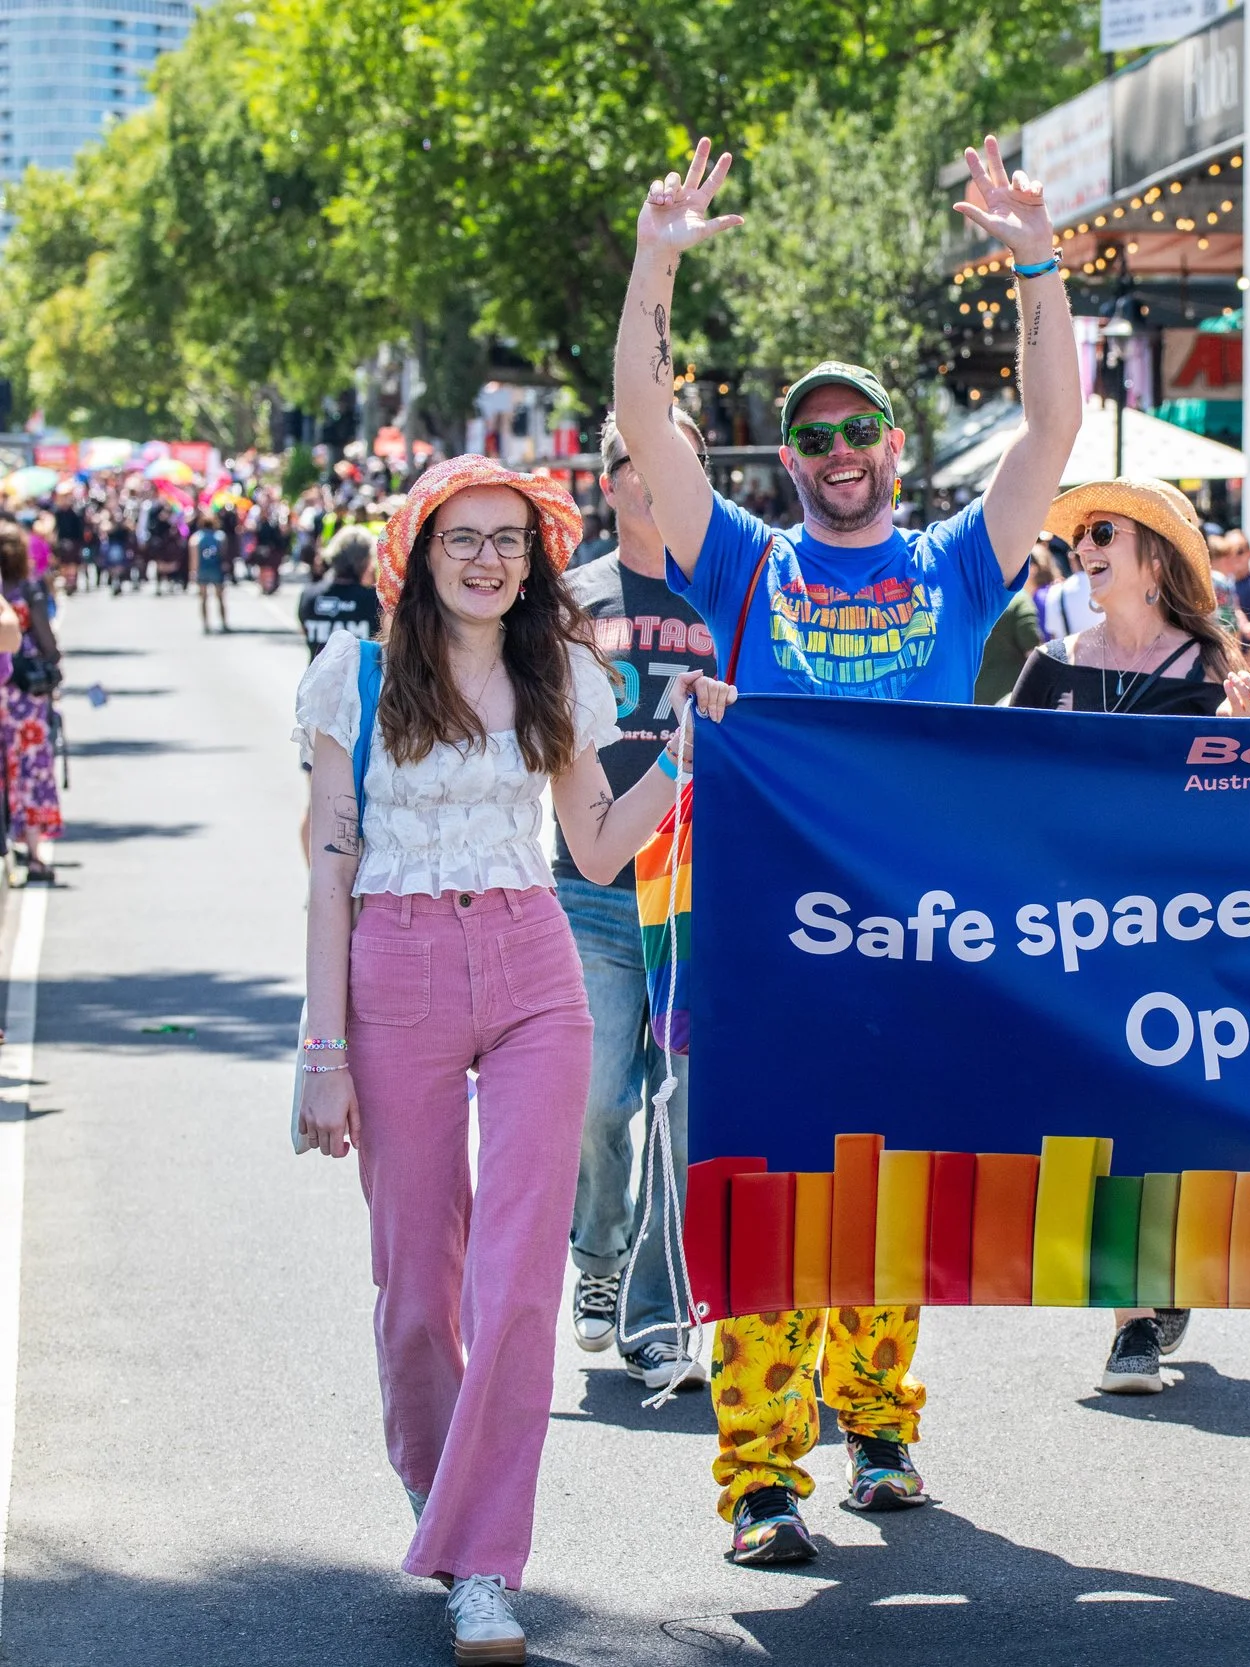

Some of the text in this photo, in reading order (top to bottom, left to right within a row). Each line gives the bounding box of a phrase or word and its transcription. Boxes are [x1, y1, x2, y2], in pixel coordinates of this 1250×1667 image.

[583, 615, 716, 656] INTAG
[621, 729, 658, 740] arts.
[789, 889, 995, 962] Safe
